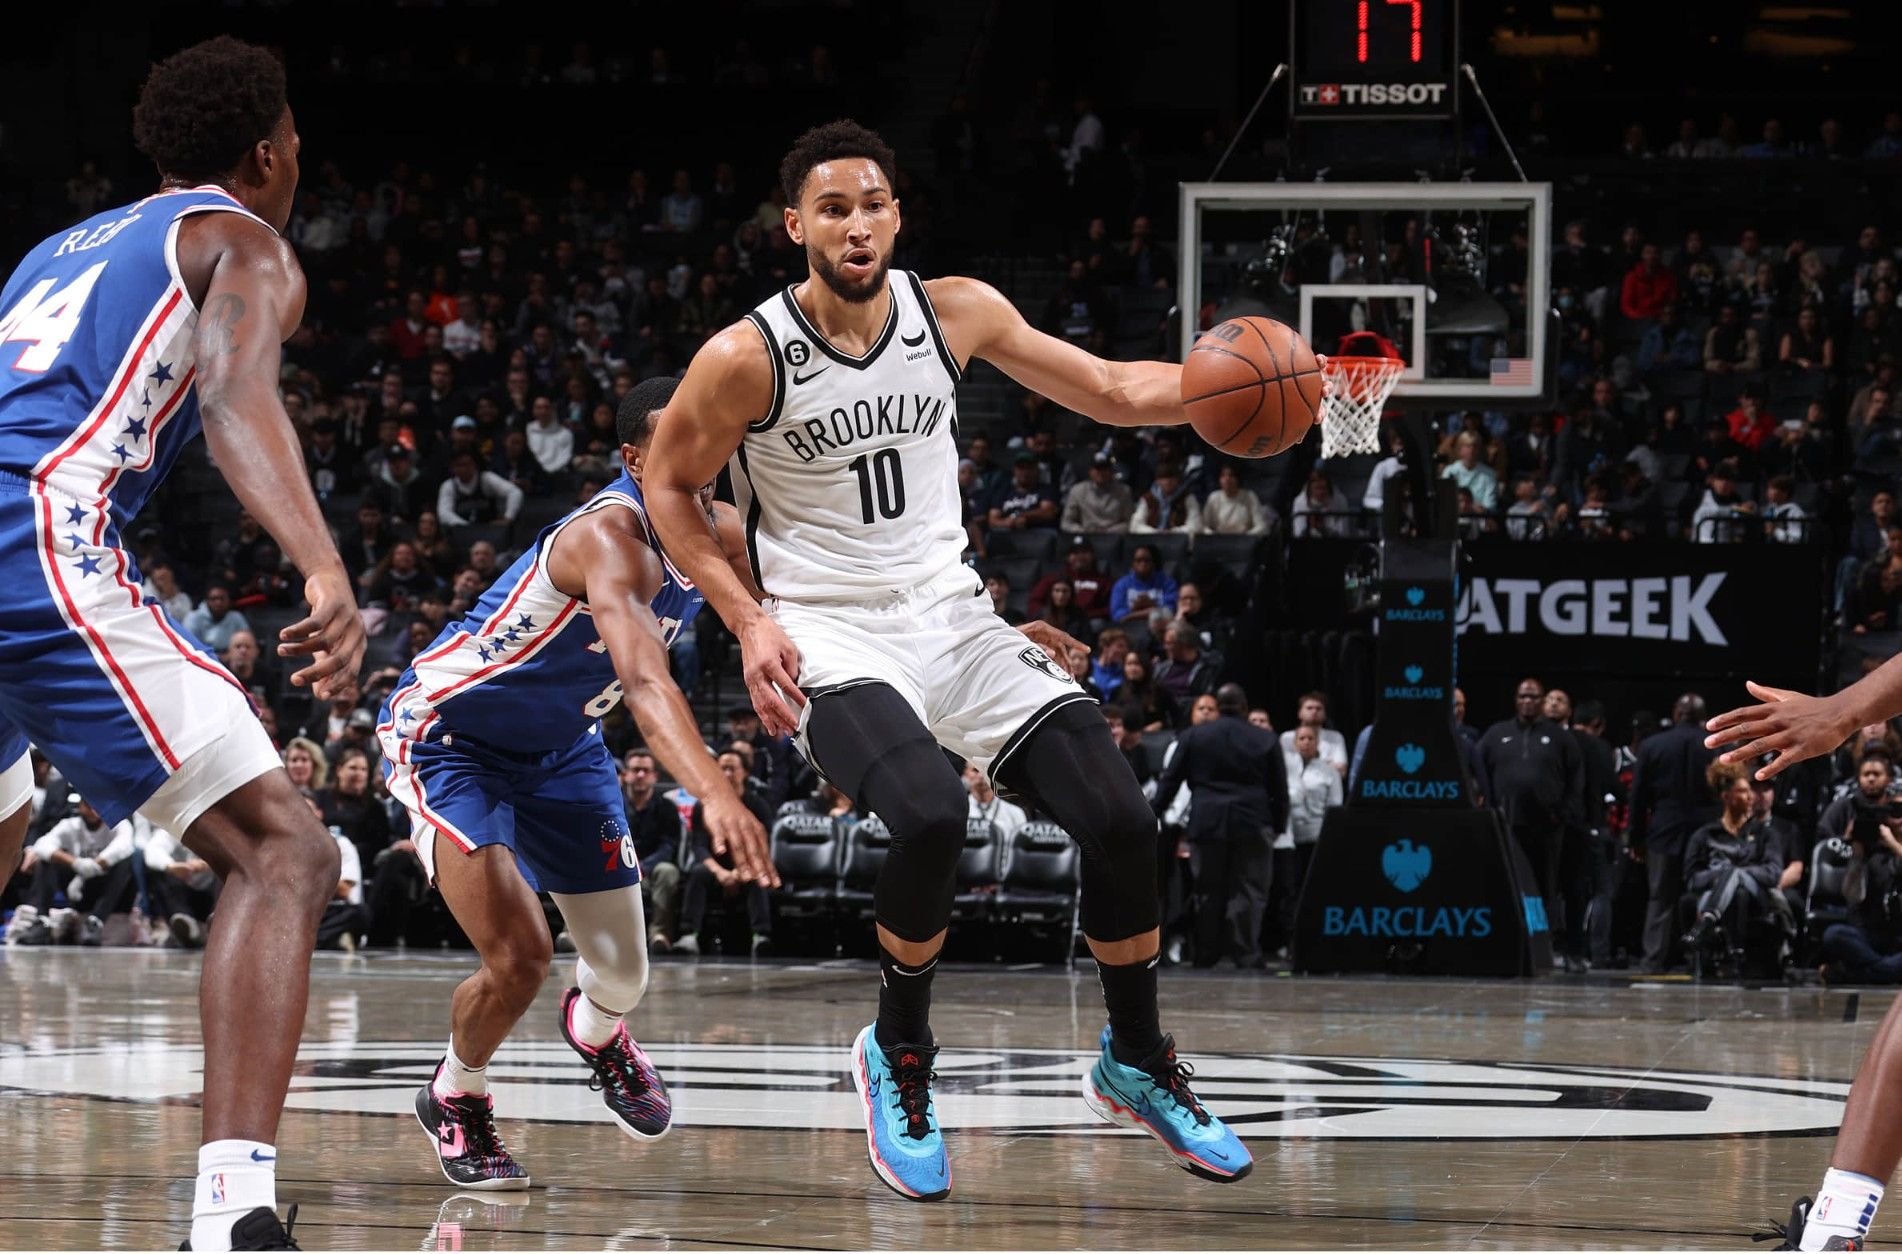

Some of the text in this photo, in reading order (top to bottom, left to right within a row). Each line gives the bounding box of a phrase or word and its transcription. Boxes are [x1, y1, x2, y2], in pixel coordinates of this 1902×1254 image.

[1357, 0, 1423, 63] 17
[1340, 83, 1447, 104] TISSOT
[788, 341, 807, 364] 6
[905, 349, 932, 362] Webull
[783, 394, 947, 462] BROOKLYN
[848, 447, 906, 525] 10
[1385, 609, 1445, 621] BARCLAYS
[1455, 571, 1729, 646] ATGEEK
[583, 679, 625, 718] 8
[1384, 687, 1443, 699] BARCLAYS
[1362, 780, 1459, 798] BARCLAYS
[783, 815, 834, 831] QATAR
[600, 834, 637, 872] 76
[1323, 906, 1492, 937] BARCLAYS
